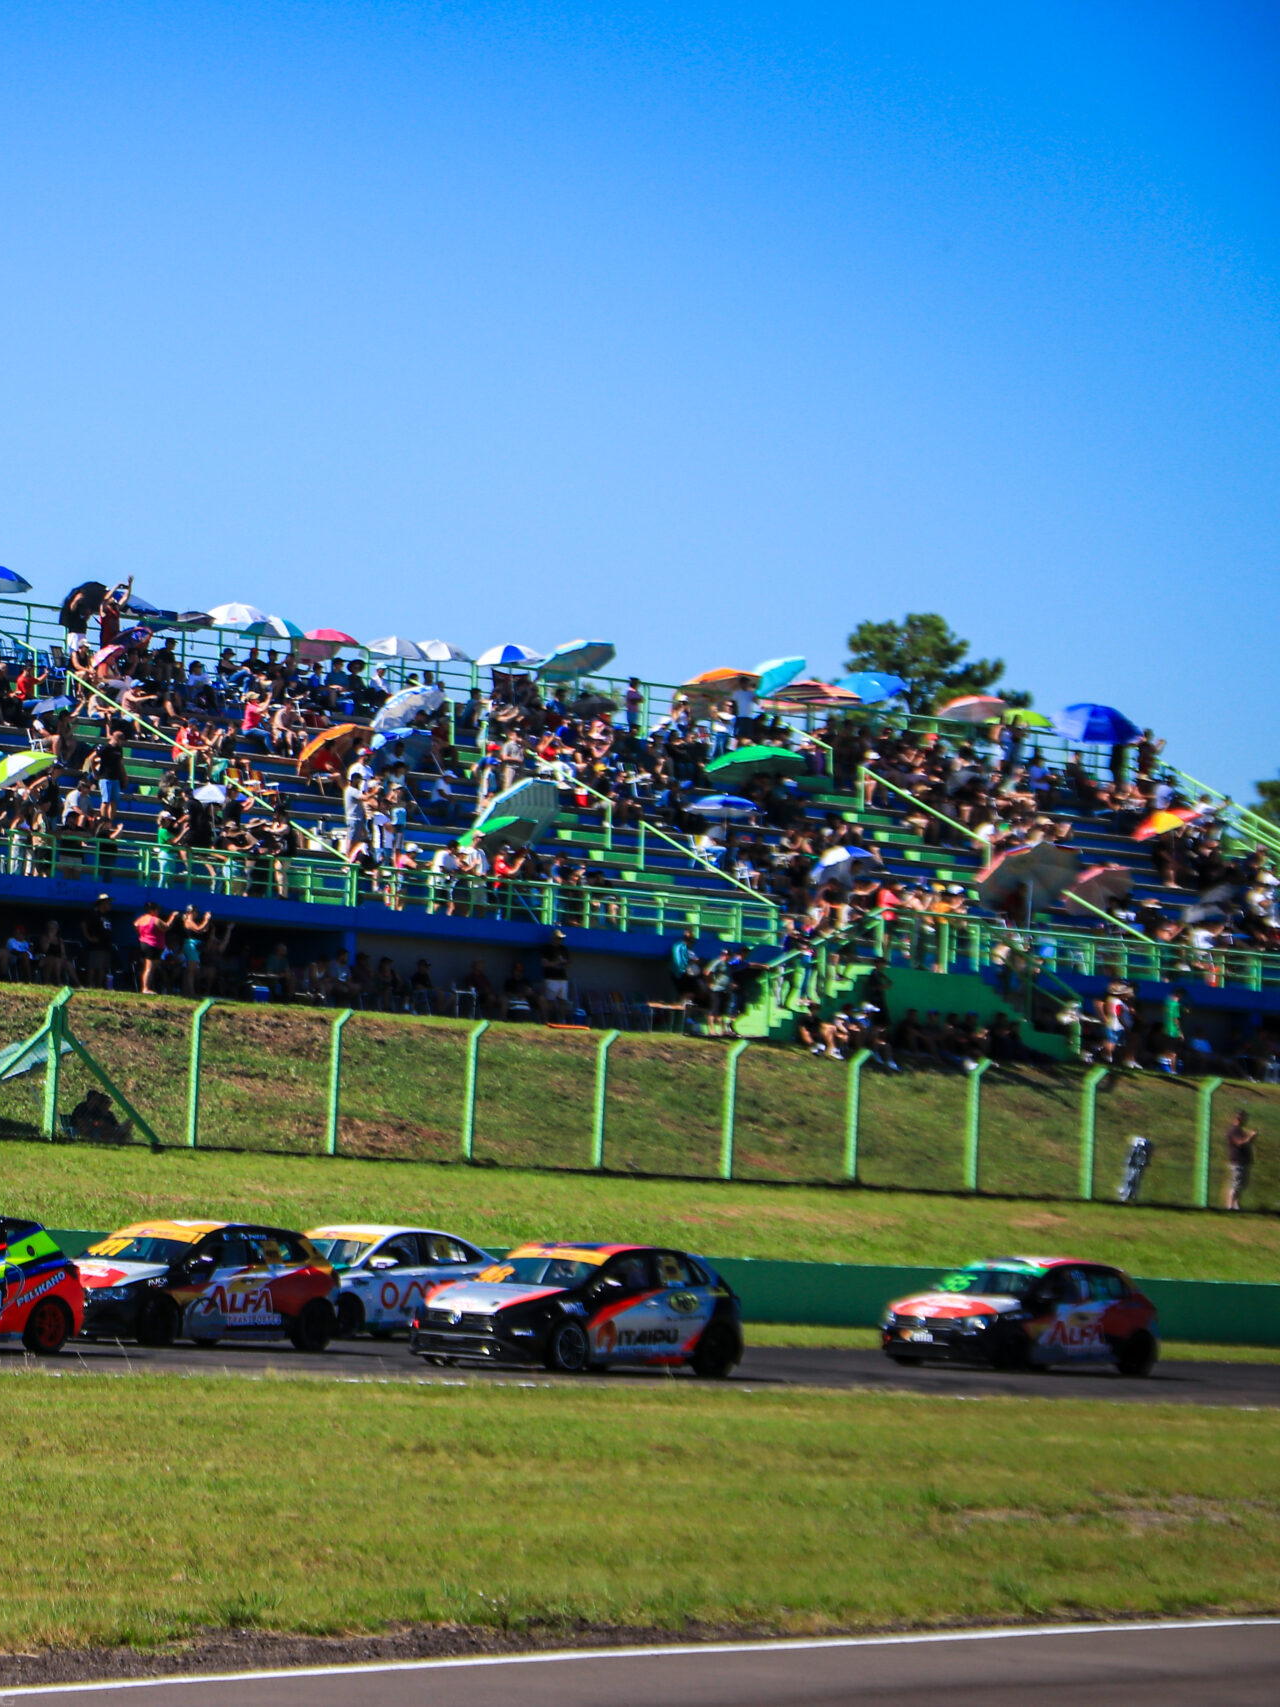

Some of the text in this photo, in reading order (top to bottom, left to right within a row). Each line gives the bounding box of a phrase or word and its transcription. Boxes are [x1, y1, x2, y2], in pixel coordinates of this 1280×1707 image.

[203, 1285, 274, 1315] ALFA
[617, 1328, 679, 1346] ITAIPU
[1047, 1320, 1106, 1346] ALFA
